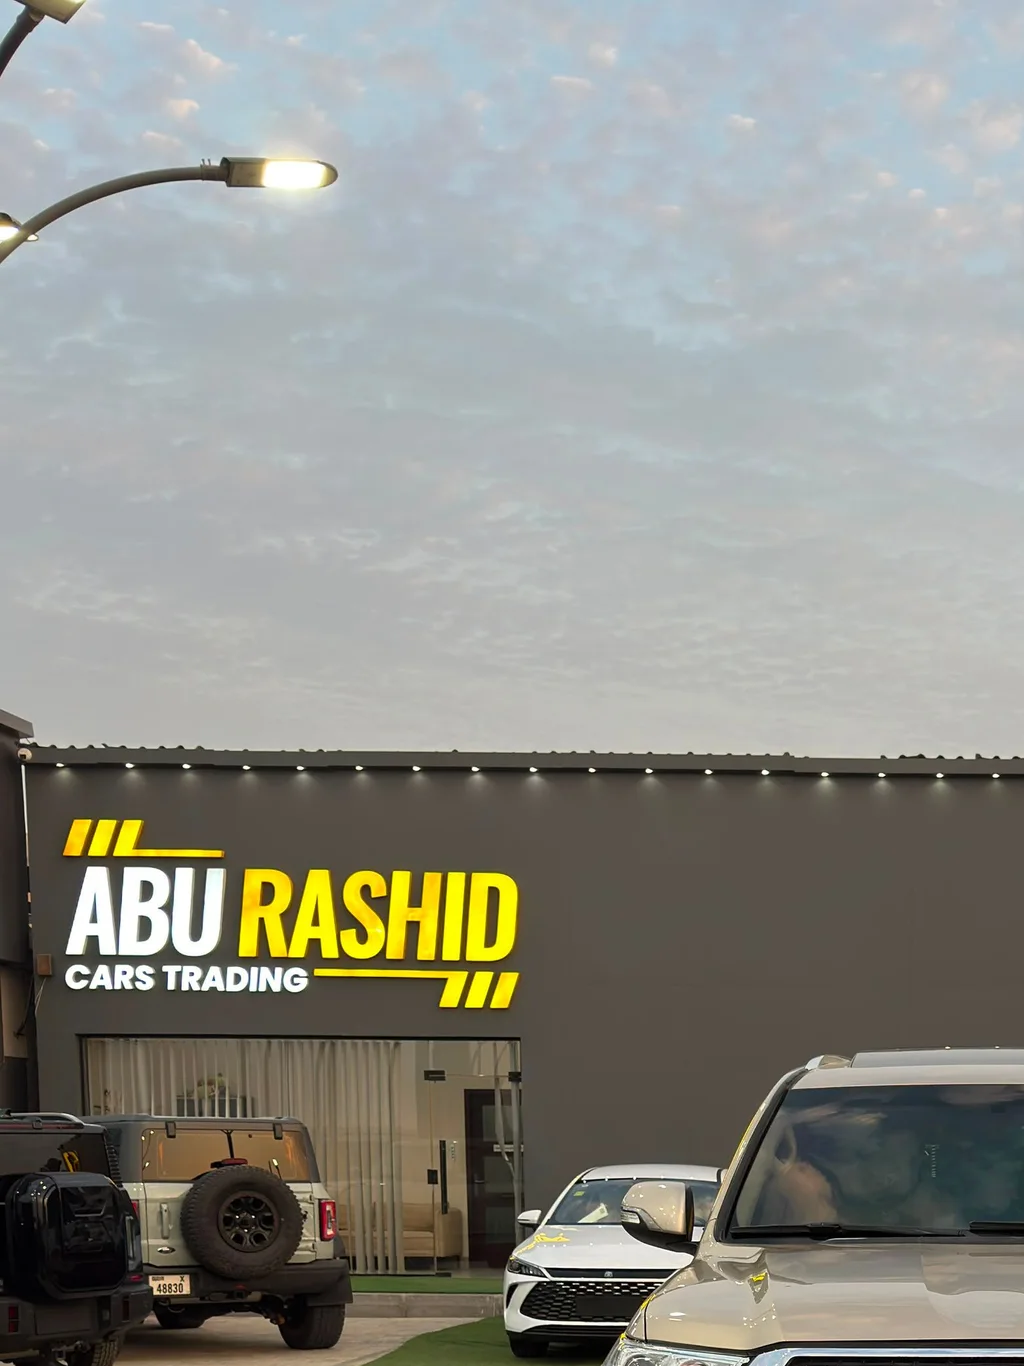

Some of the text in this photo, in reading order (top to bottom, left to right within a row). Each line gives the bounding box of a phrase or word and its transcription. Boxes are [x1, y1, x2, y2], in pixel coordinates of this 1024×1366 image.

[65, 866, 519, 962] ABU RASHID
[64, 964, 310, 993] CARS TRADING
[157, 1283, 184, 1294] 48830
